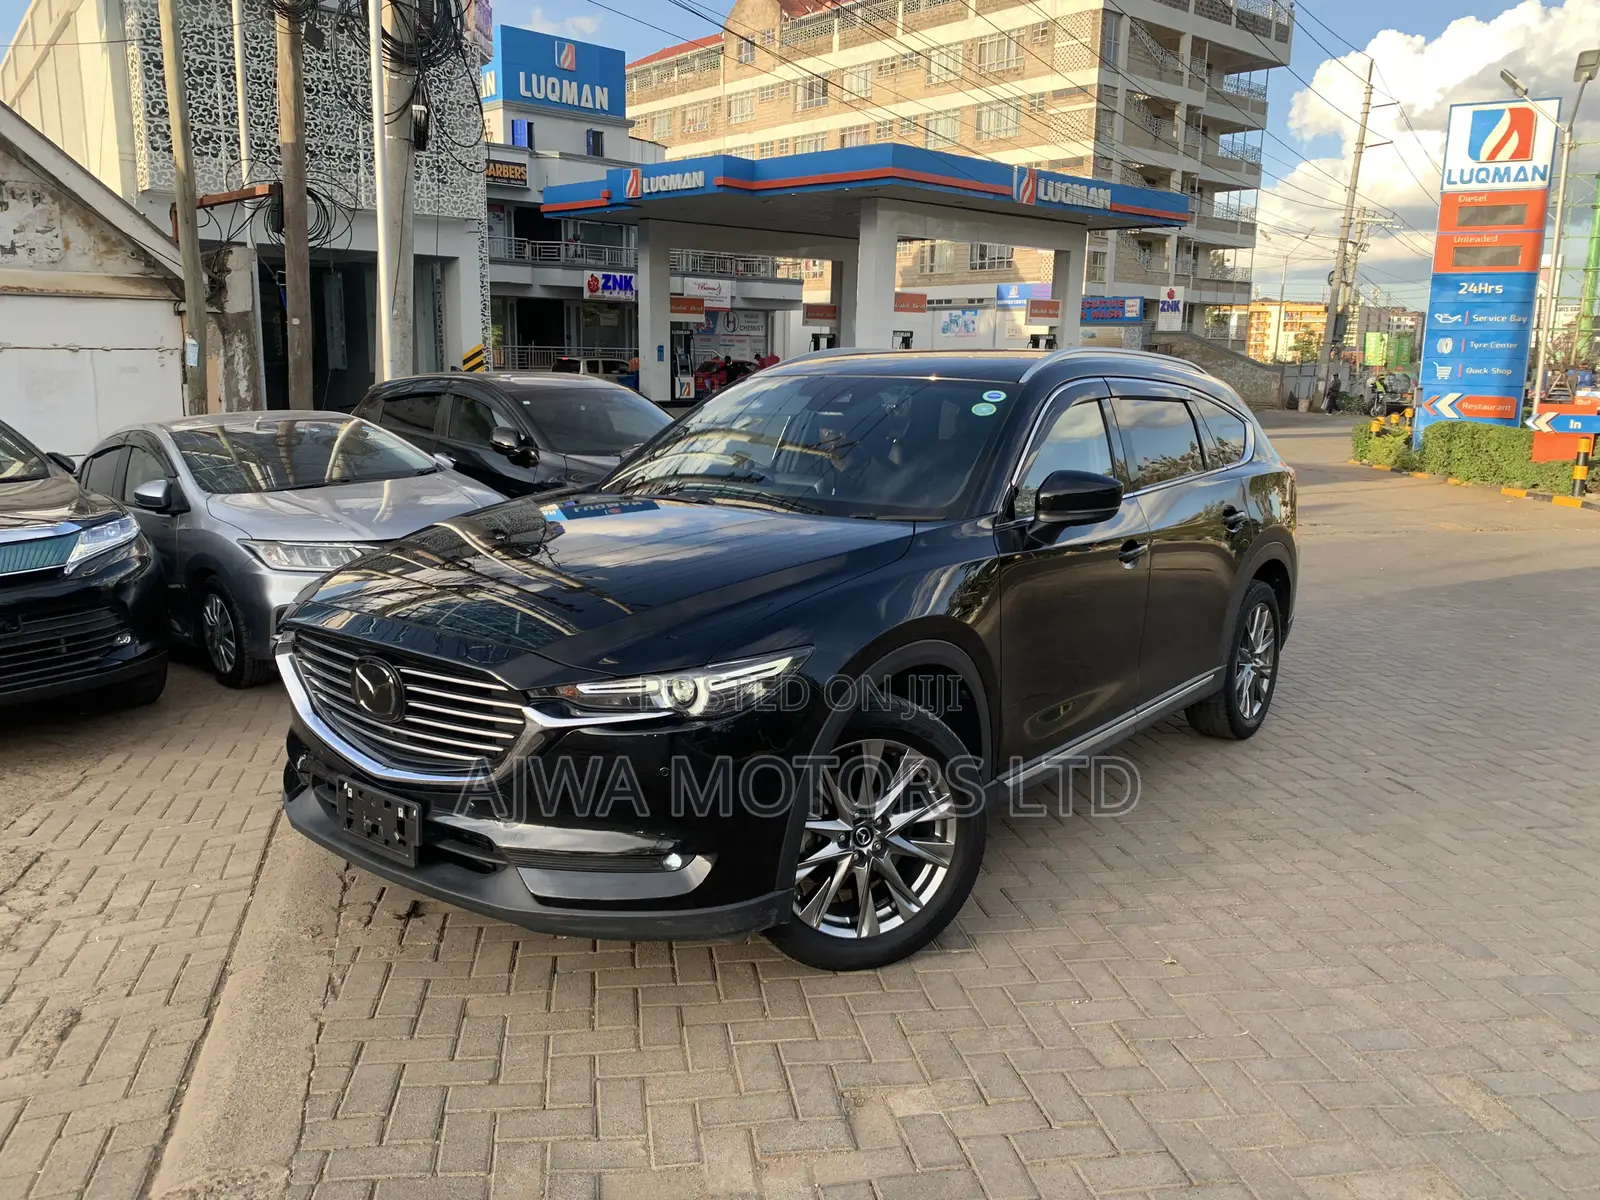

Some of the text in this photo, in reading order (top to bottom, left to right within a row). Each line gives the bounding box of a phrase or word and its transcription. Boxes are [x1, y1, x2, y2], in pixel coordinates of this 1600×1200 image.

[519, 71, 609, 111] LUQMAN
[1446, 164, 1549, 185] LUQMAN
[643, 170, 705, 193] LUQMAN
[1038, 178, 1112, 210] LUQMAN
[1458, 193, 1488, 203] Diesel
[1453, 234, 1499, 244] Unleaded
[601, 273, 634, 291] ZNK
[1458, 282, 1504, 295] 24Hrs
[1160, 300, 1180, 313] ZNK
[1472, 314, 1527, 325] Service Bay
[1469, 341, 1518, 350] Tyre Center
[1466, 367, 1512, 376] Quick Shop
[1461, 402, 1512, 412] Restaurant
[1569, 419, 1582, 430] In
